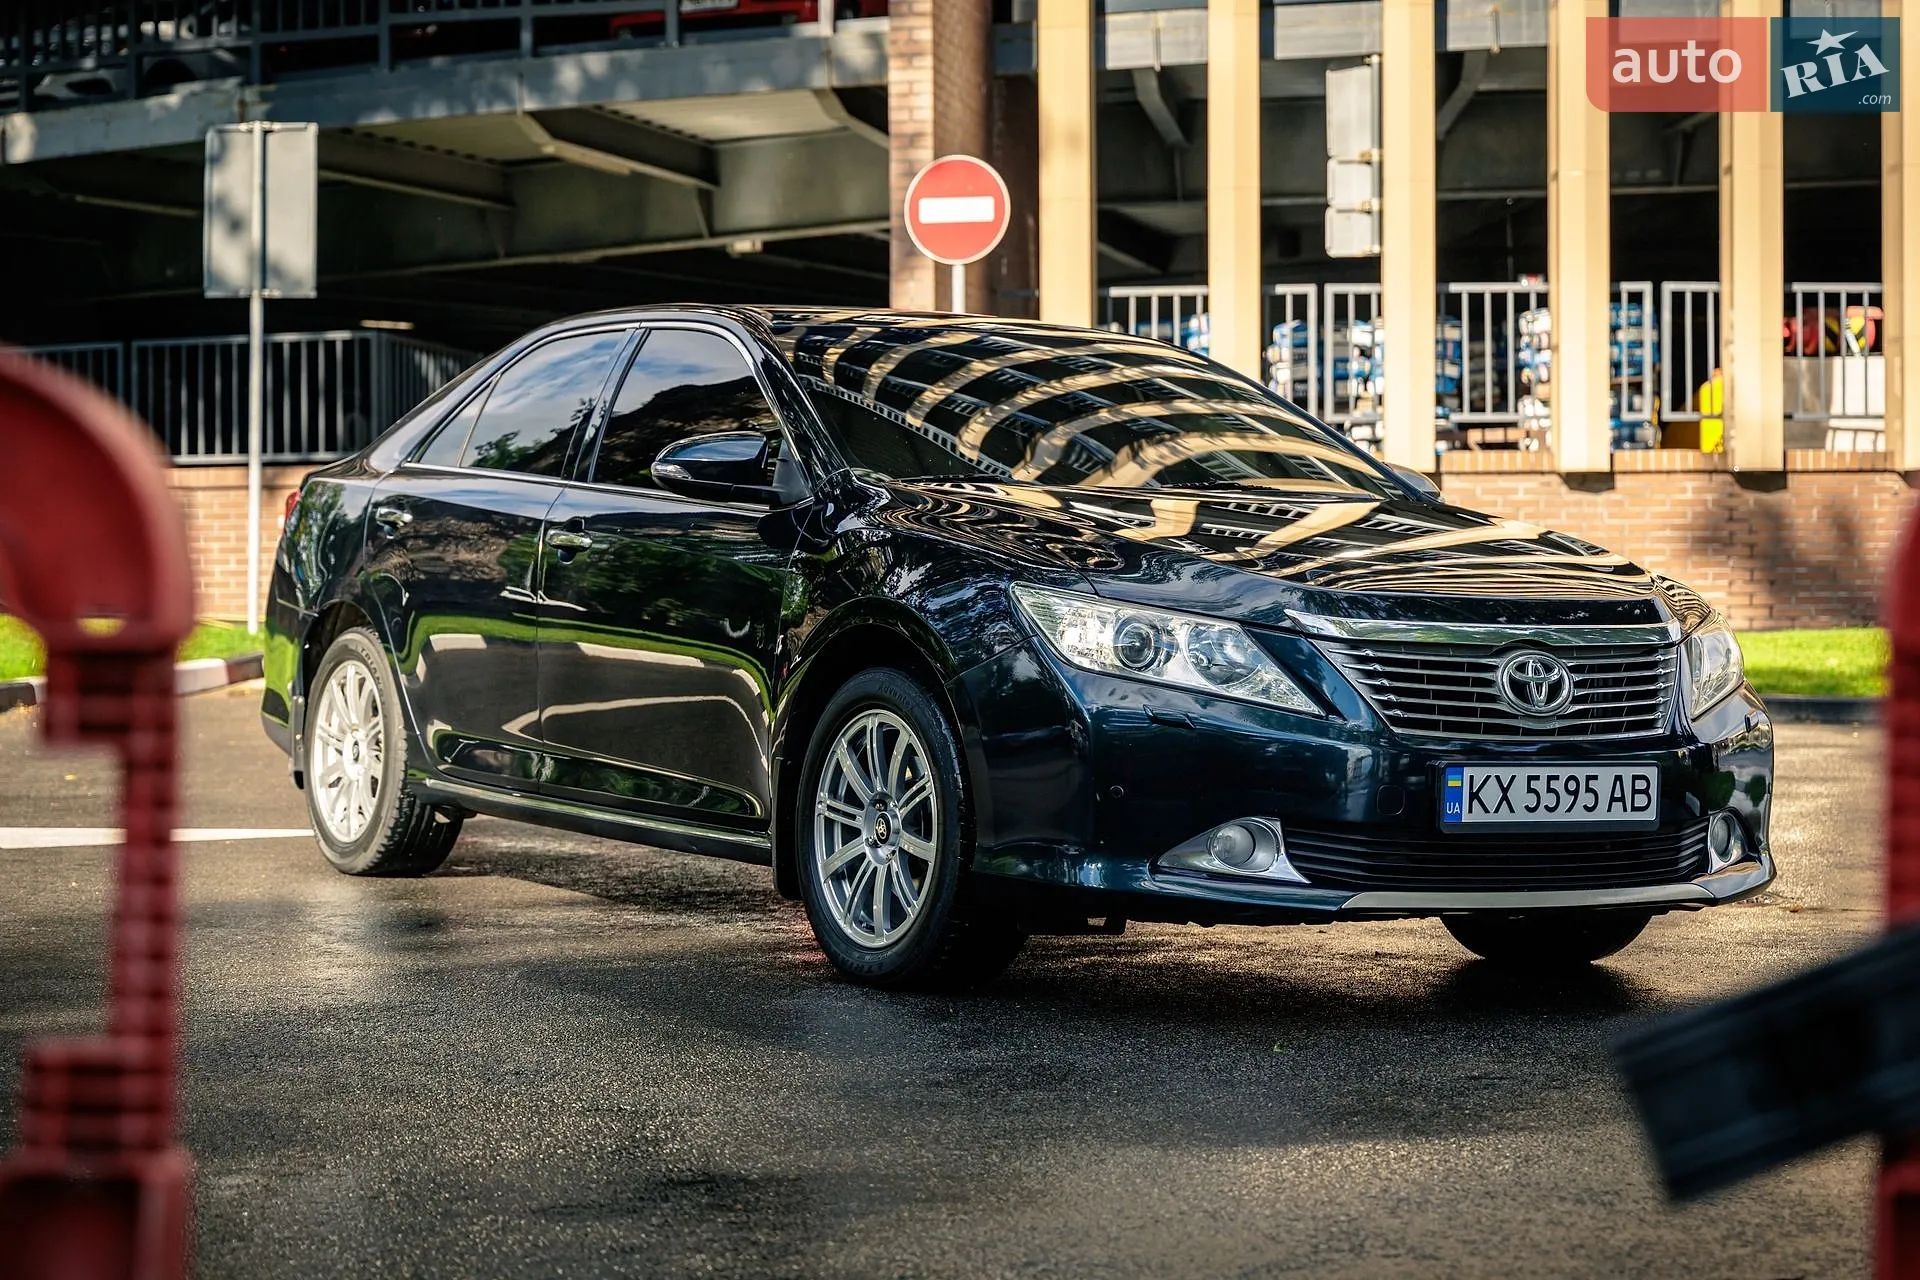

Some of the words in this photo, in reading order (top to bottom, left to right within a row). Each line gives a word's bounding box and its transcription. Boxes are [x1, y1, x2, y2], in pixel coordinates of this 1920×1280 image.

[1467, 774, 1517, 814] KX
[1524, 774, 1600, 814] 5595
[1606, 774, 1652, 813] AB
[1446, 802, 1461, 815] UA
